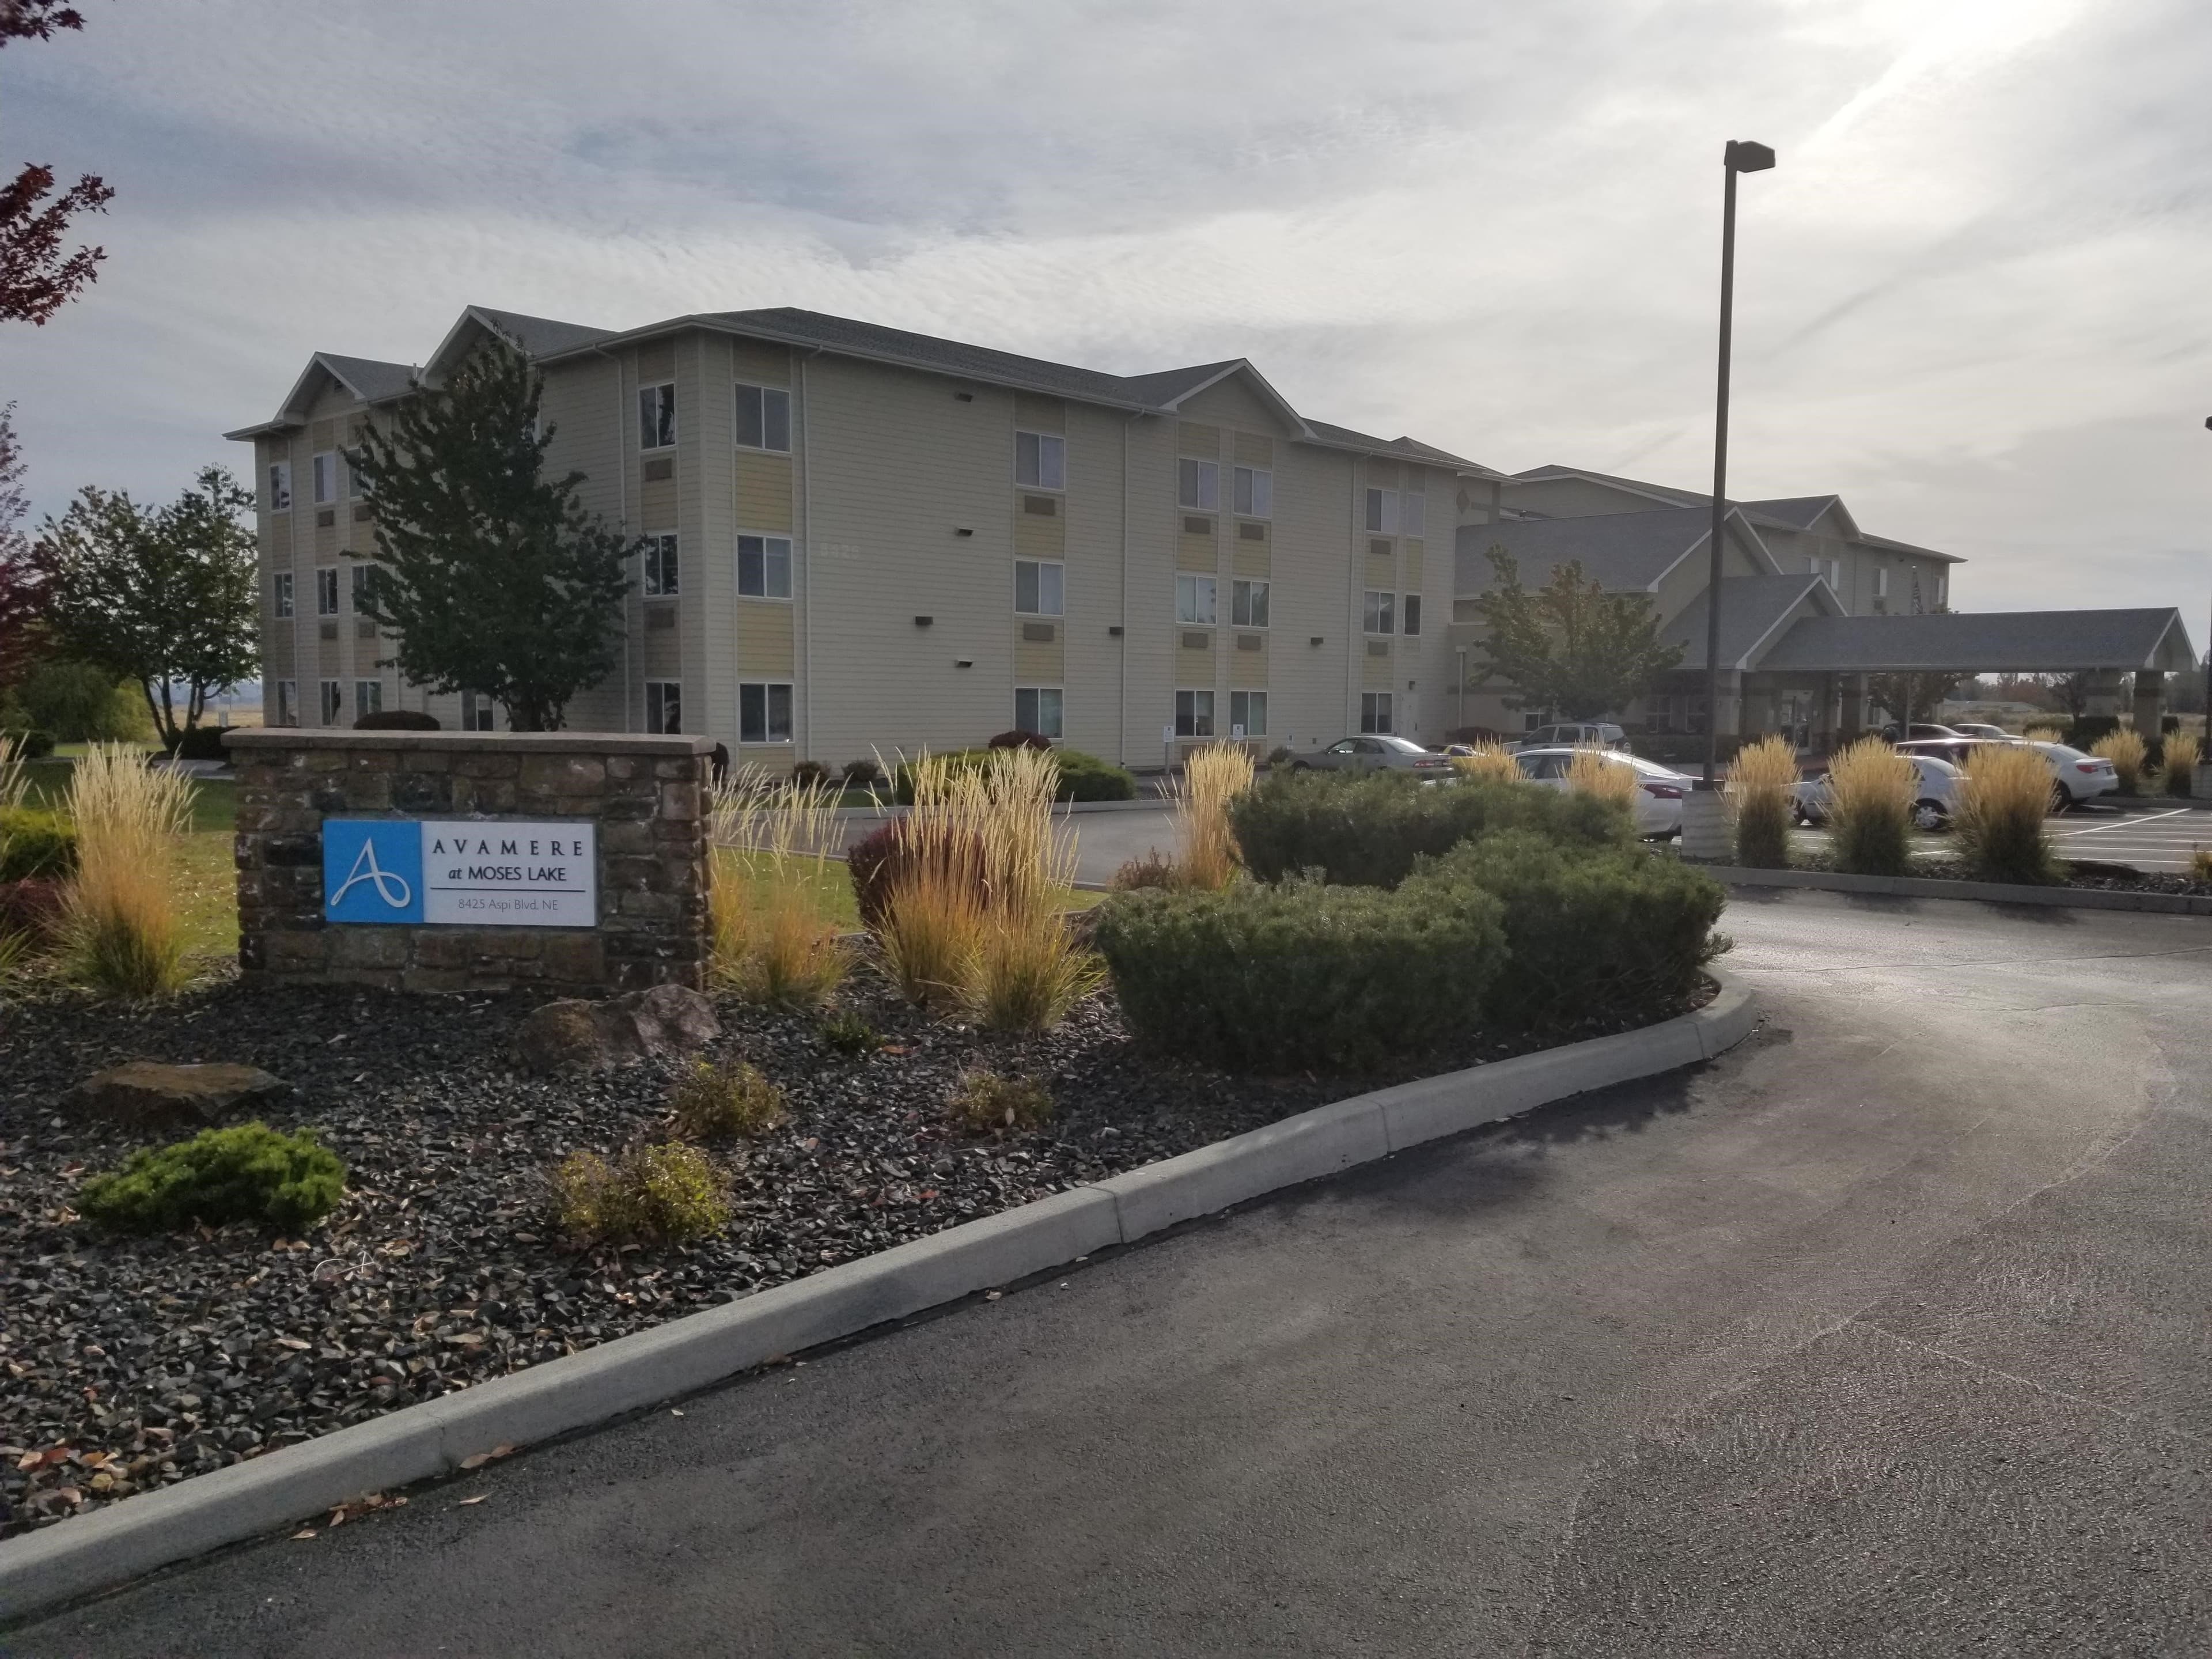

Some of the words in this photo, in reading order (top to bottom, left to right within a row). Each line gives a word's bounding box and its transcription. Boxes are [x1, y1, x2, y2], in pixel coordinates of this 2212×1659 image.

[433, 839, 582, 856] AVAMERE
[448, 867, 462, 880] at
[468, 866, 521, 881] MOSES
[528, 867, 567, 881] LAKE
[459, 899, 485, 909] 8425
[488, 899, 512, 912] Aspi
[543, 900, 559, 910] NE
